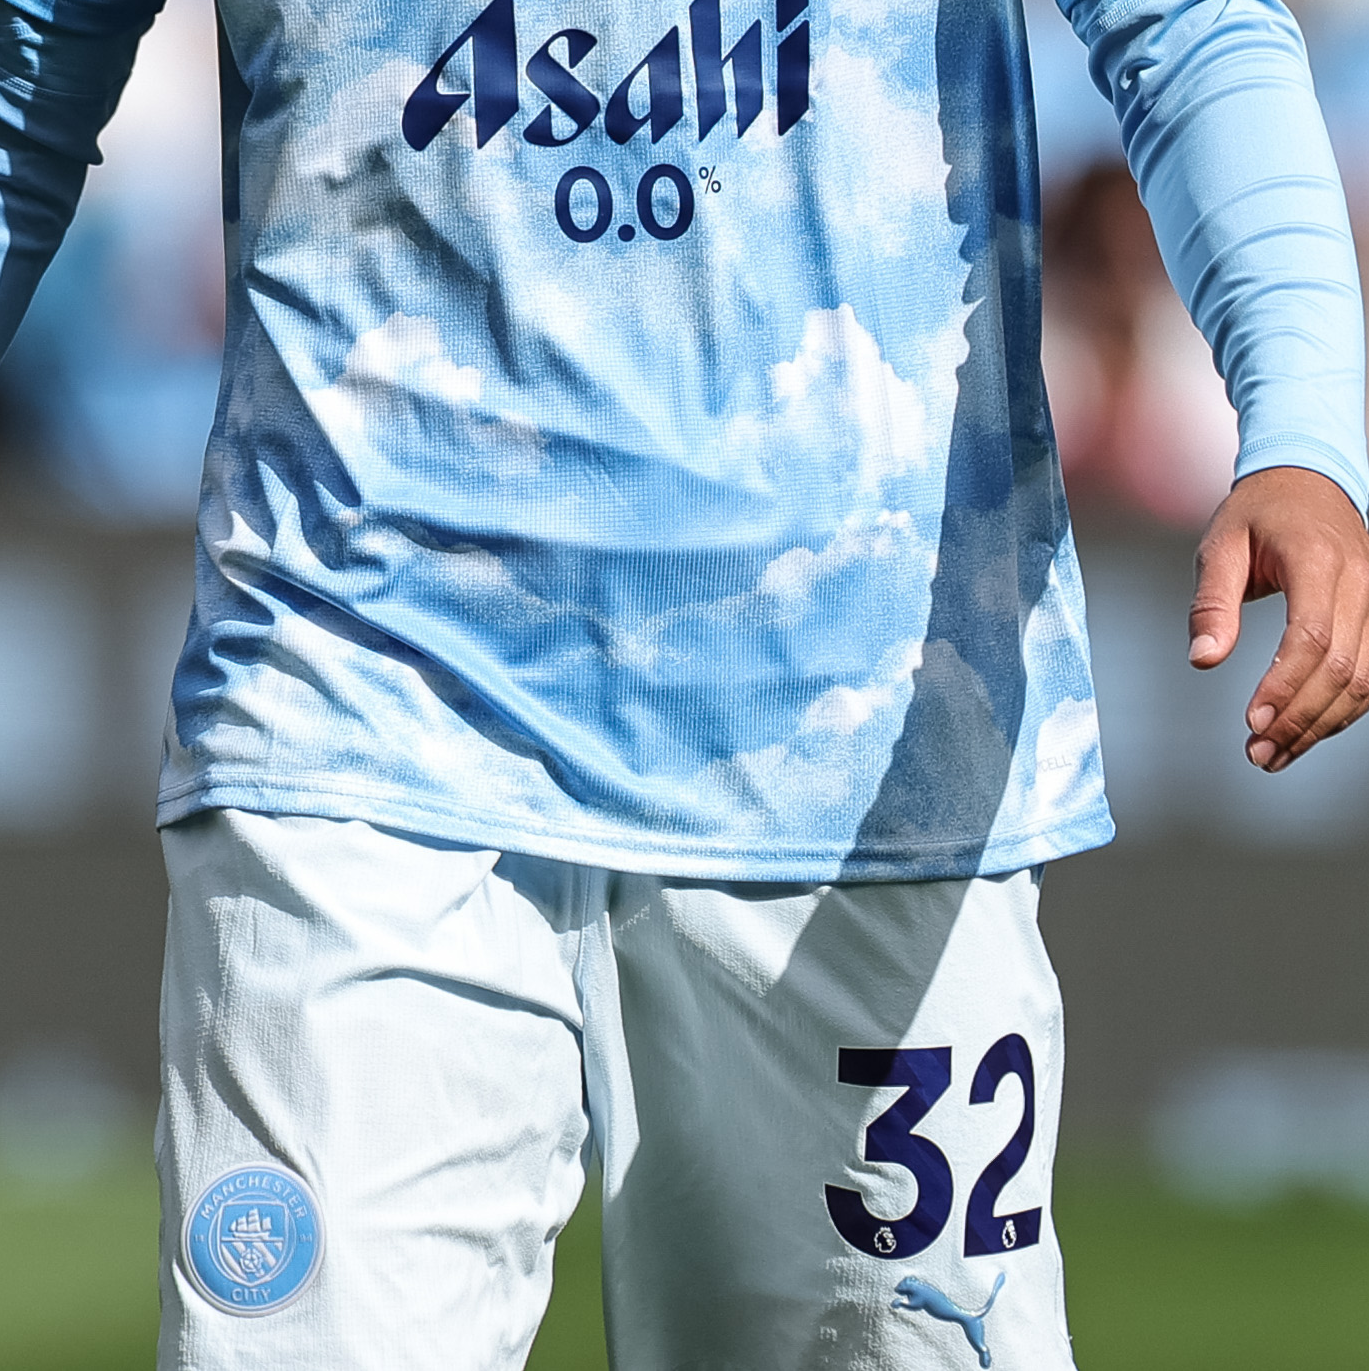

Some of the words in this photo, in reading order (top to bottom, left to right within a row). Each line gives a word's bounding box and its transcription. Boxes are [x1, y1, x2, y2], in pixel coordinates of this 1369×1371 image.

[824, 1033, 1042, 1260] 32
[200, 1175, 308, 1221] MANCHESTER
[232, 1288, 271, 1303] CITY
